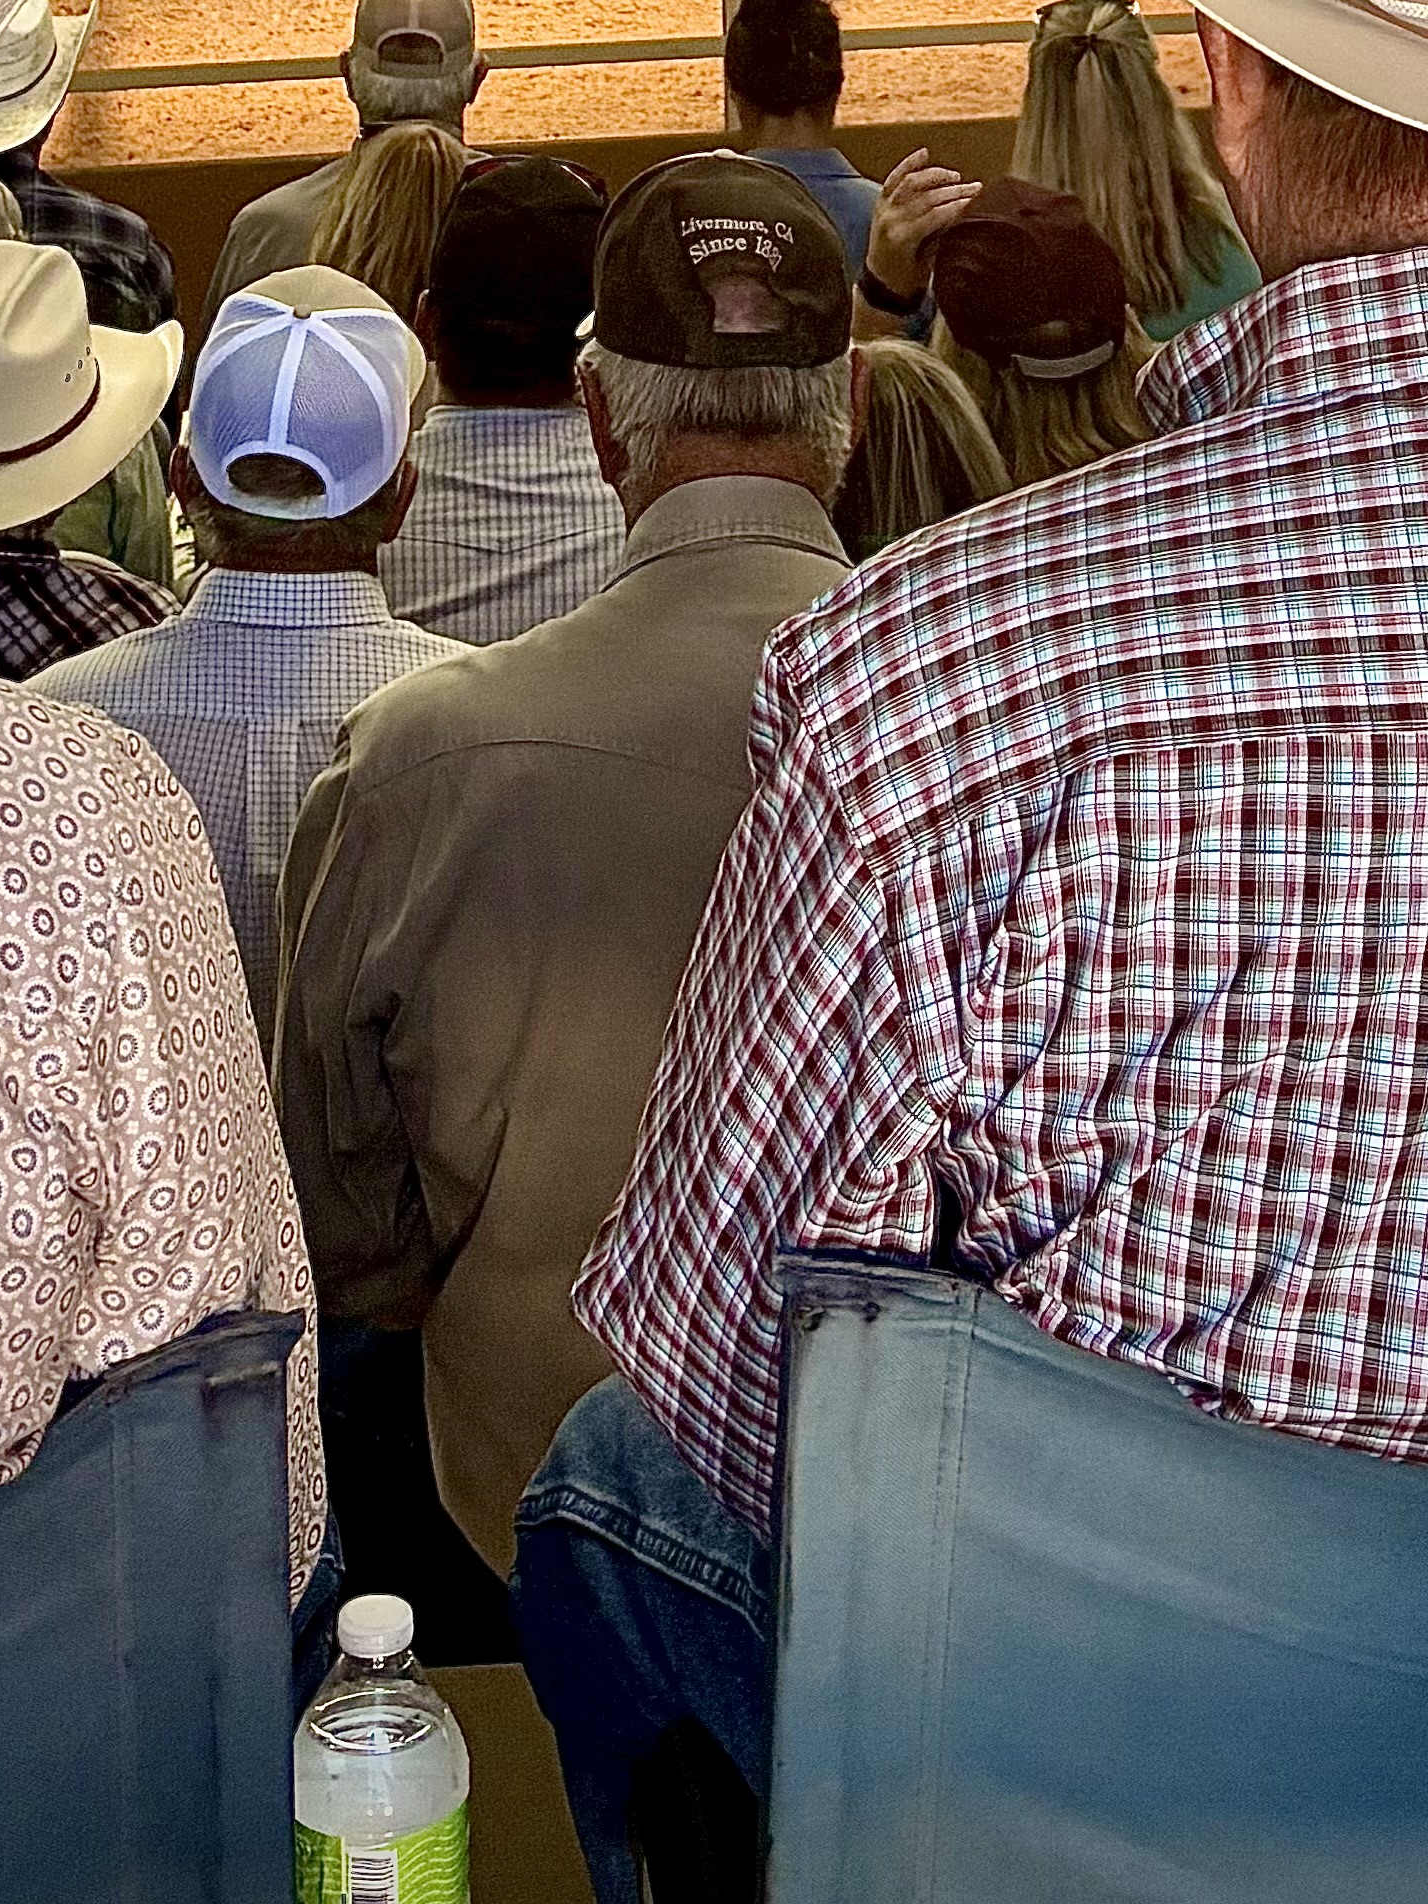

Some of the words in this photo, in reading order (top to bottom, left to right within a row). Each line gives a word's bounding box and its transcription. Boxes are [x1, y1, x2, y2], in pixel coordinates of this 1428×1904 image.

[681, 217, 769, 236] Livermore,
[775, 222, 794, 244] CA
[689, 237, 747, 264] Since
